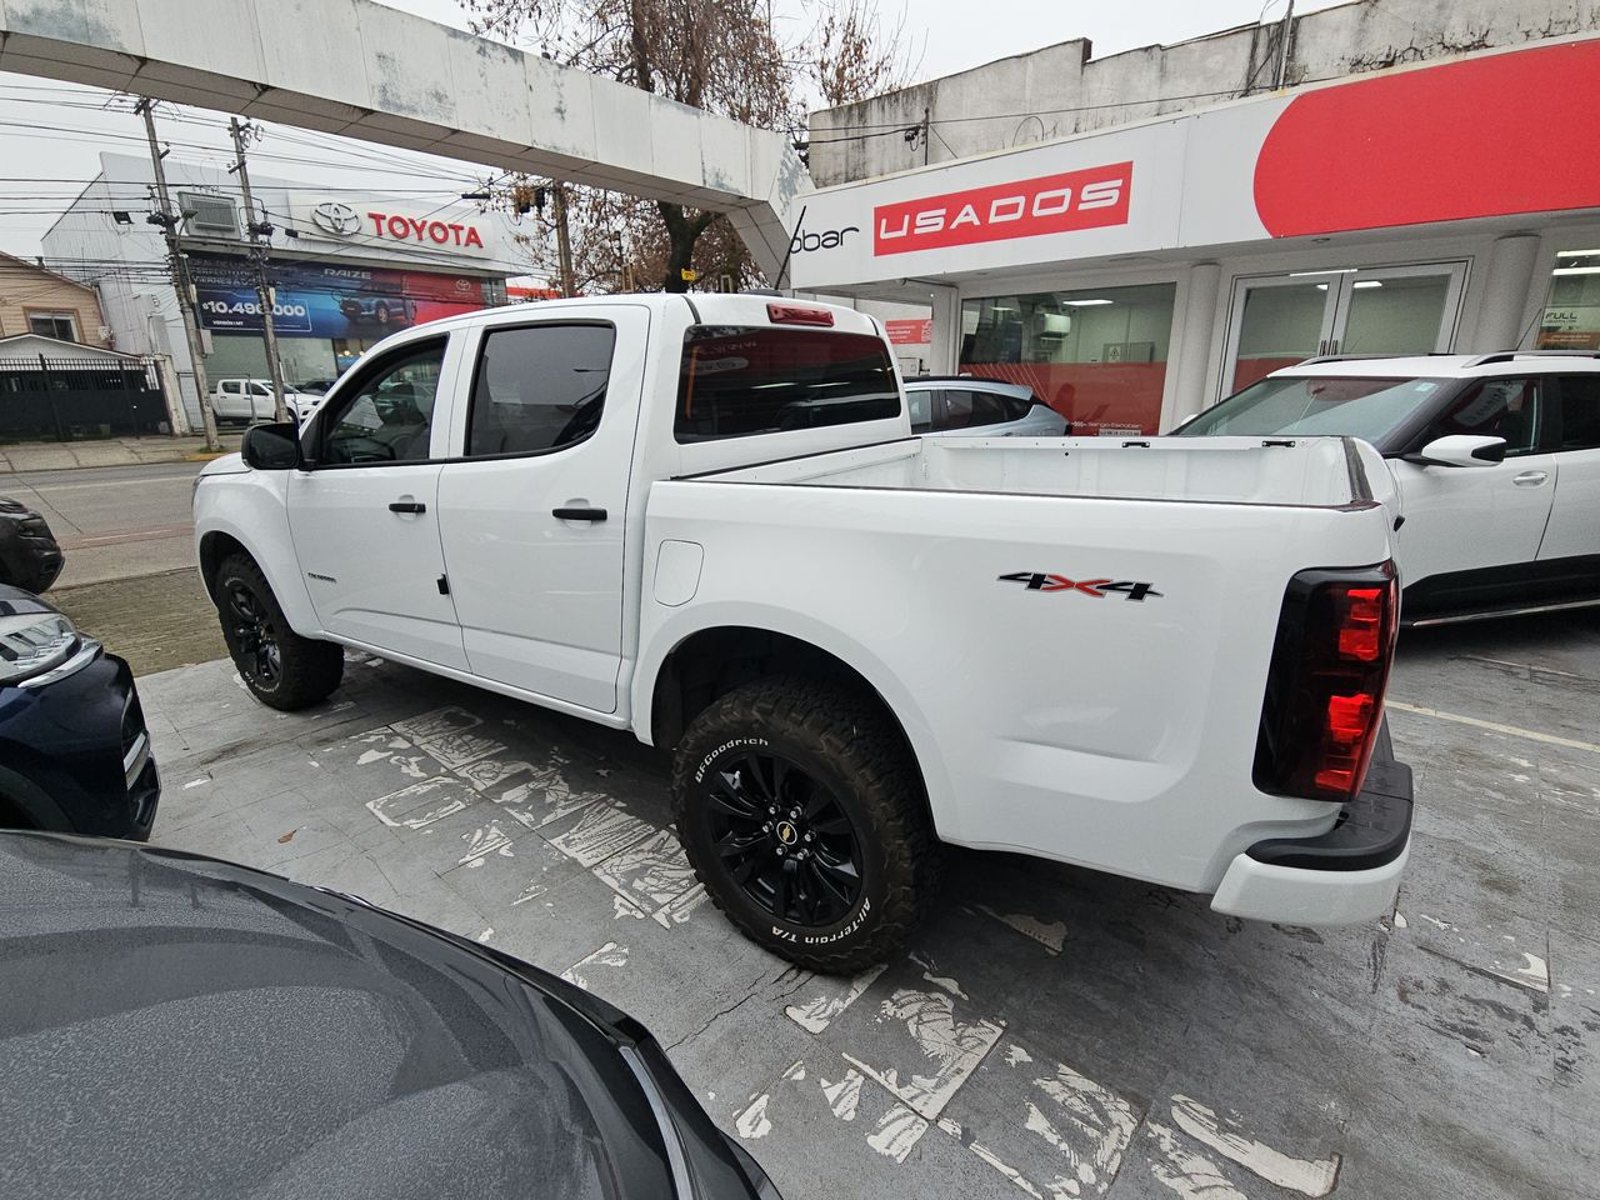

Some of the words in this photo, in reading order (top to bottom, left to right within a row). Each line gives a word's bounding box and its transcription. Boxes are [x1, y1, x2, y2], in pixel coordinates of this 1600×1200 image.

[878, 178, 1124, 240] USADOS
[367, 211, 484, 249] TOYOTA
[323, 267, 373, 280] RAIZE
[202, 300, 306, 317] $10.490000
[695, 737, 769, 783] BFGoodrich
[772, 926, 797, 943] T/A
